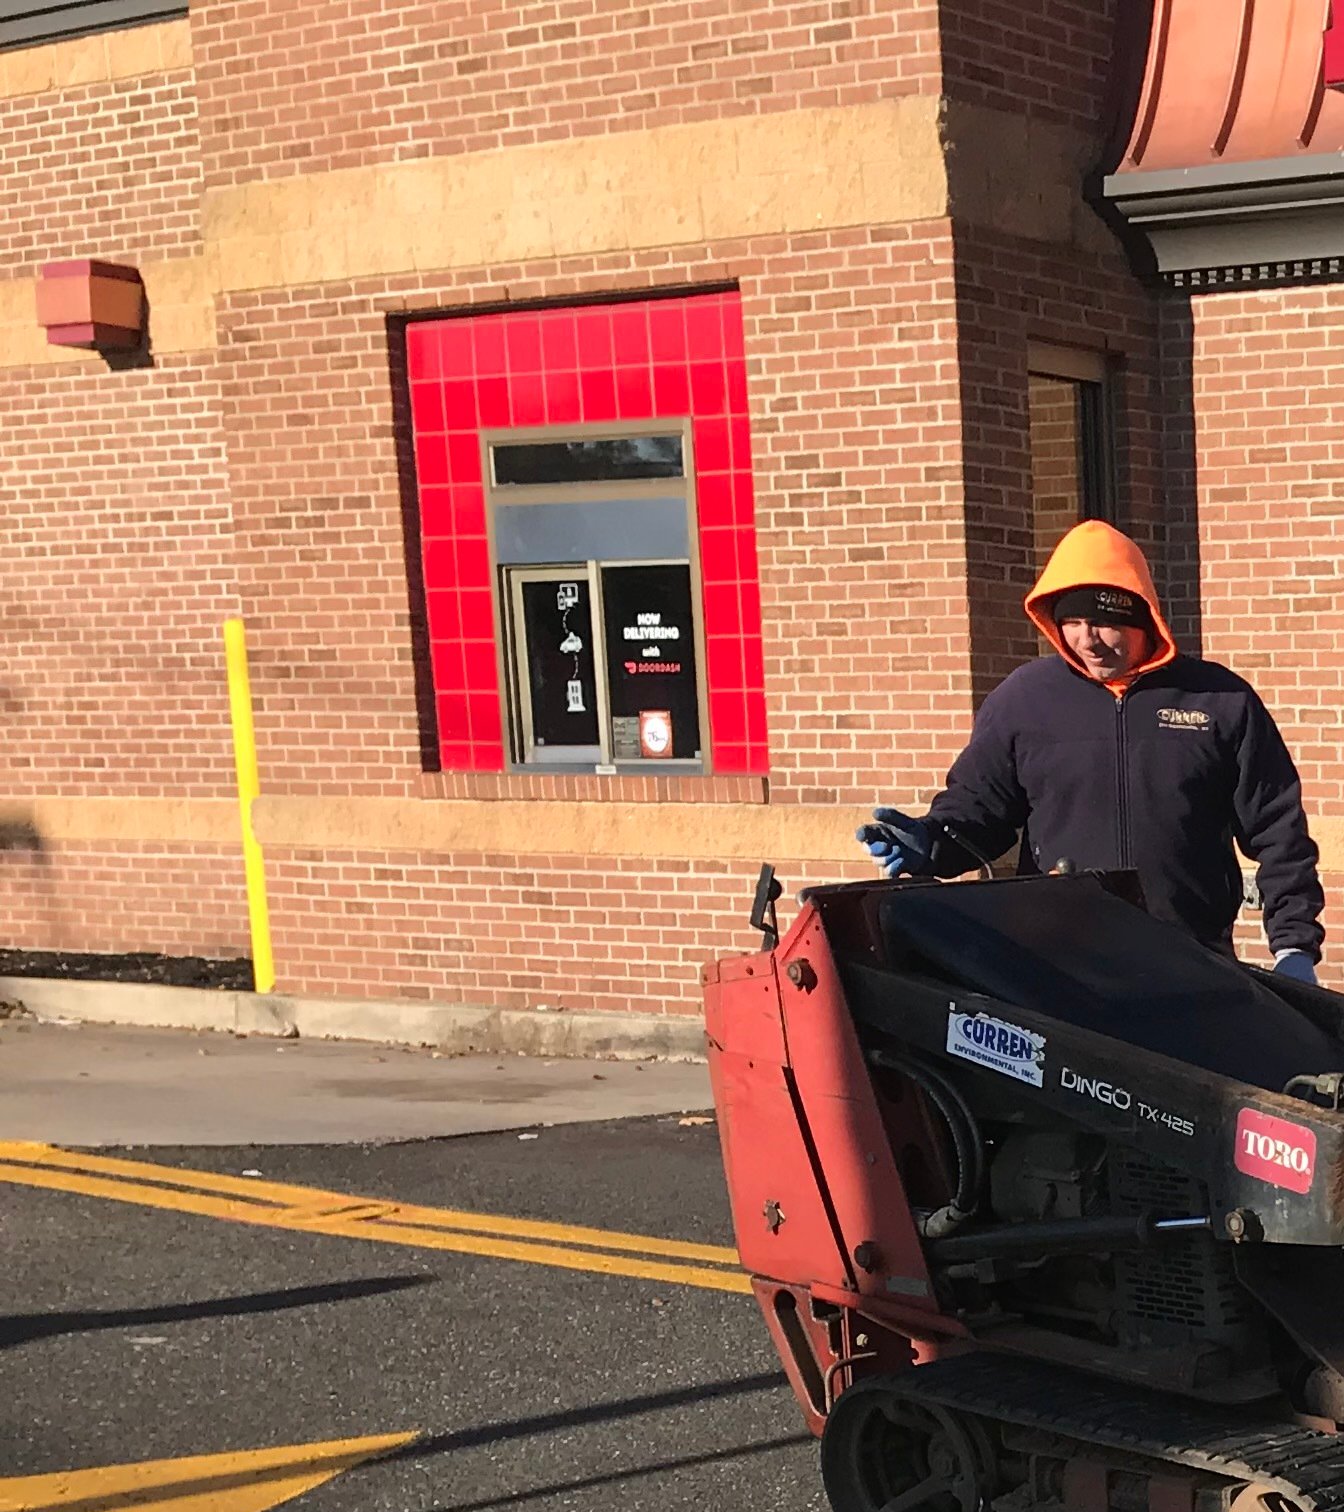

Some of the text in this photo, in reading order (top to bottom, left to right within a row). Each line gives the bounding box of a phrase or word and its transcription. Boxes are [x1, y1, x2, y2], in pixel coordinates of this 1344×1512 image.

[637, 613, 661, 626] NOW
[623, 626, 680, 640] DELIVERING
[642, 646, 660, 657] with
[638, 662, 680, 673] DOORDASH
[962, 1019, 1032, 1059] CURREN
[1060, 1067, 1131, 1110] DINGO
[1242, 1128, 1309, 1173] TORO
